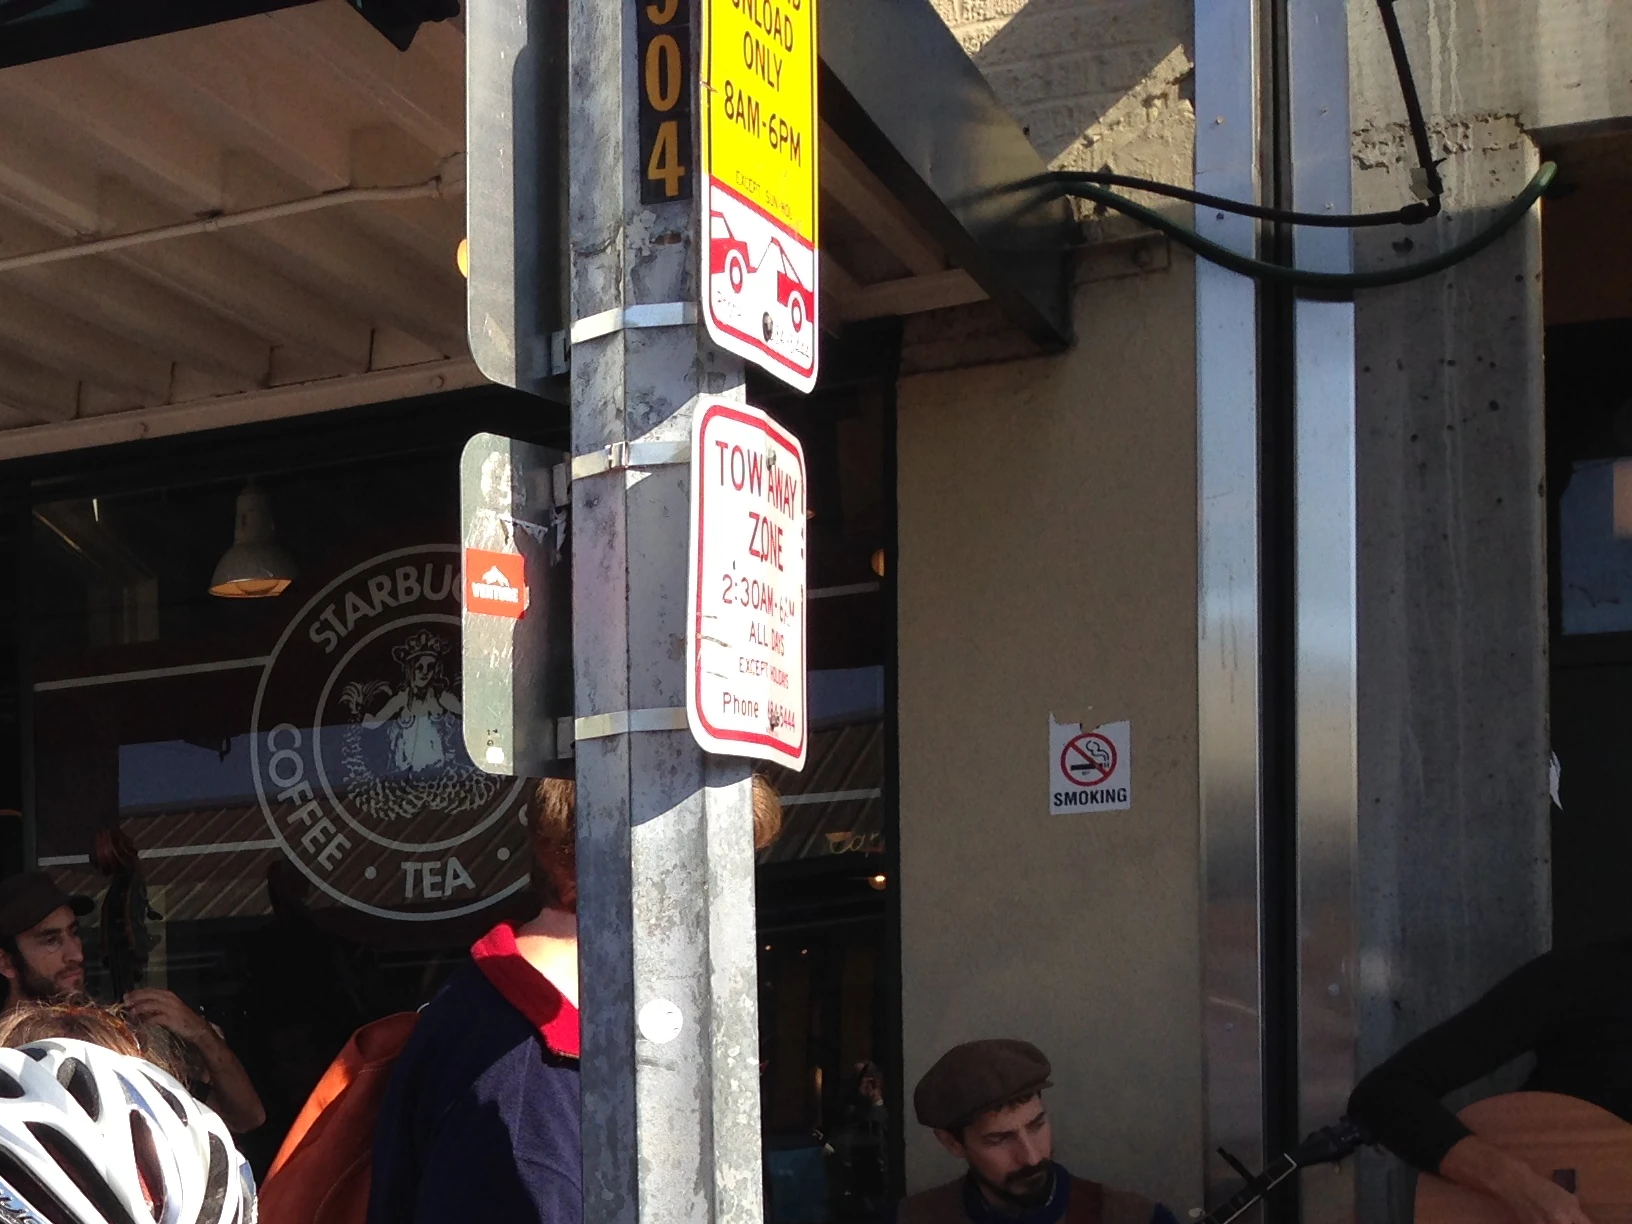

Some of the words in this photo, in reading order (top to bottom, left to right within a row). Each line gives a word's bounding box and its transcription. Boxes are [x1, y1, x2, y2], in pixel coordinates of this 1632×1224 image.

[732, 0, 793, 52] NLOAD
[743, 31, 782, 92] ONLY
[723, 81, 801, 167] 8AM-6PM
[715, 440, 763, 497] TOW
[768, 465, 797, 521] AWAY
[749, 511, 784, 572] ZONE
[309, 563, 463, 654] STARBU
[749, 621, 768, 647] ALL
[770, 628, 785, 657] DAYS
[739, 656, 769, 678] EXCEPT
[722, 692, 759, 718] Phone
[268, 722, 351, 873] COFFEE
[401, 856, 476, 899] TEA
[1053, 787, 1128, 808] SMOKING
